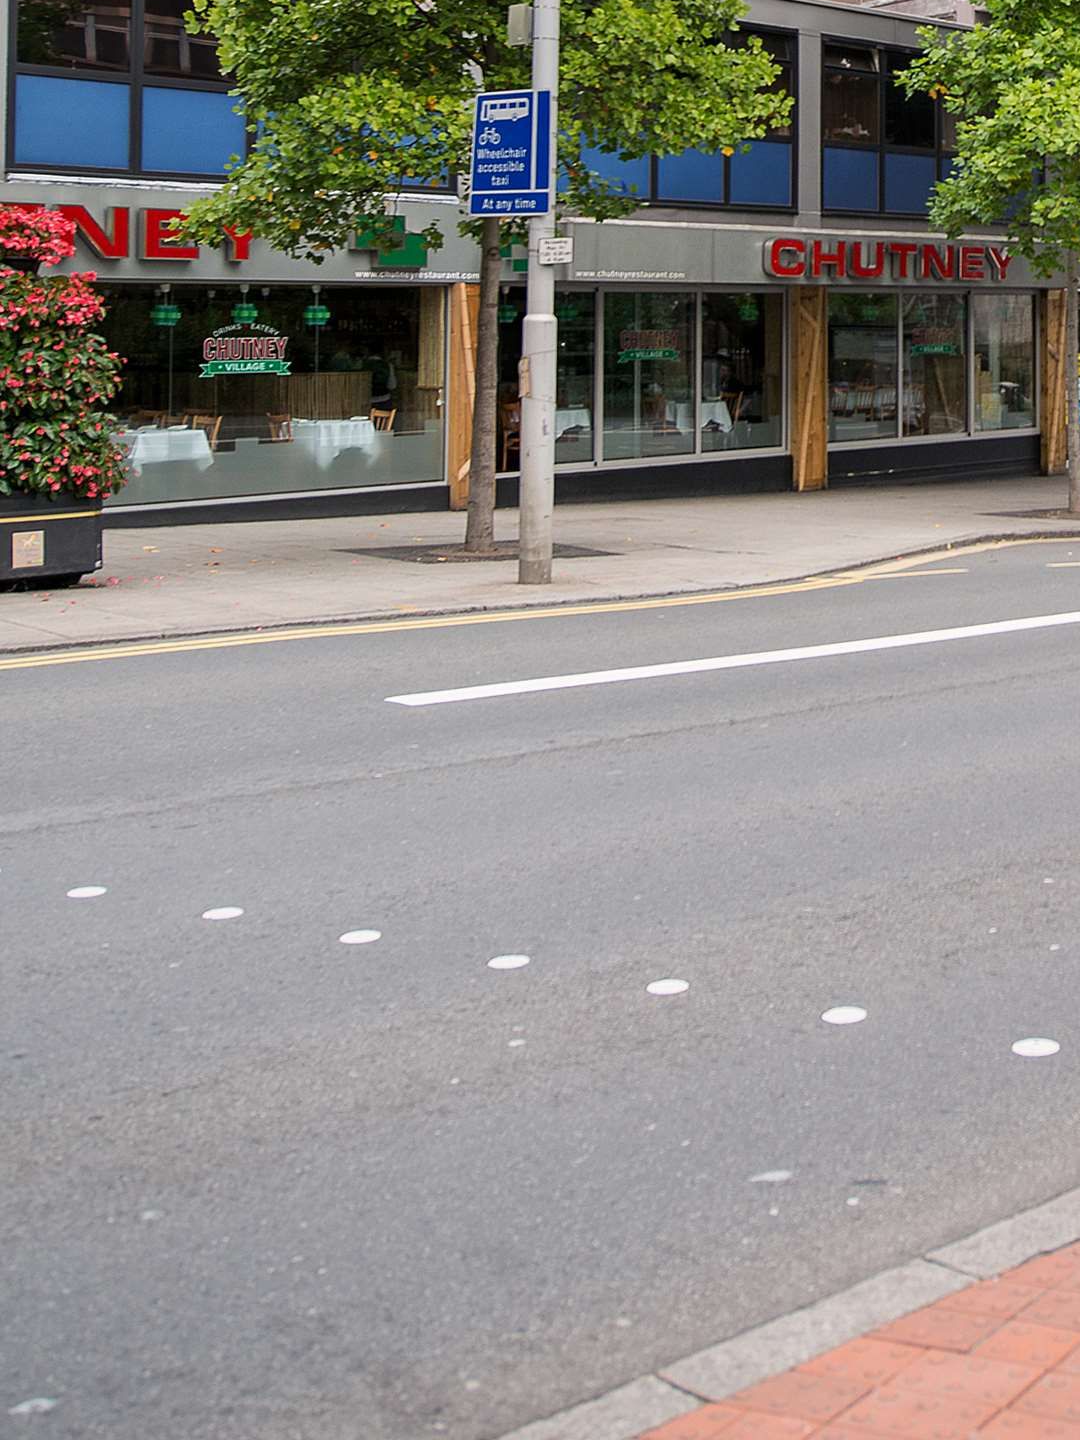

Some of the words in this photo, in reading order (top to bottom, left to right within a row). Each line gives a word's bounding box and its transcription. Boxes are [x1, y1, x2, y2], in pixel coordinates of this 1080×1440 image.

[477, 147, 527, 160] Wheelchair
[477, 161, 525, 173] accessible
[491, 175, 510, 186] taxi
[482, 198, 494, 209] At
[496, 200, 512, 211] any
[515, 198, 537, 209] time
[769, 238, 1013, 280] CHUTNEY
[575, 270, 686, 280] www.chutneyrestaurant.com
[212, 323, 243, 337] DRINKS
[250, 322, 281, 336] EATERY
[203, 336, 289, 361] CHUTNEY
[224, 363, 266, 371] VILLAGE
